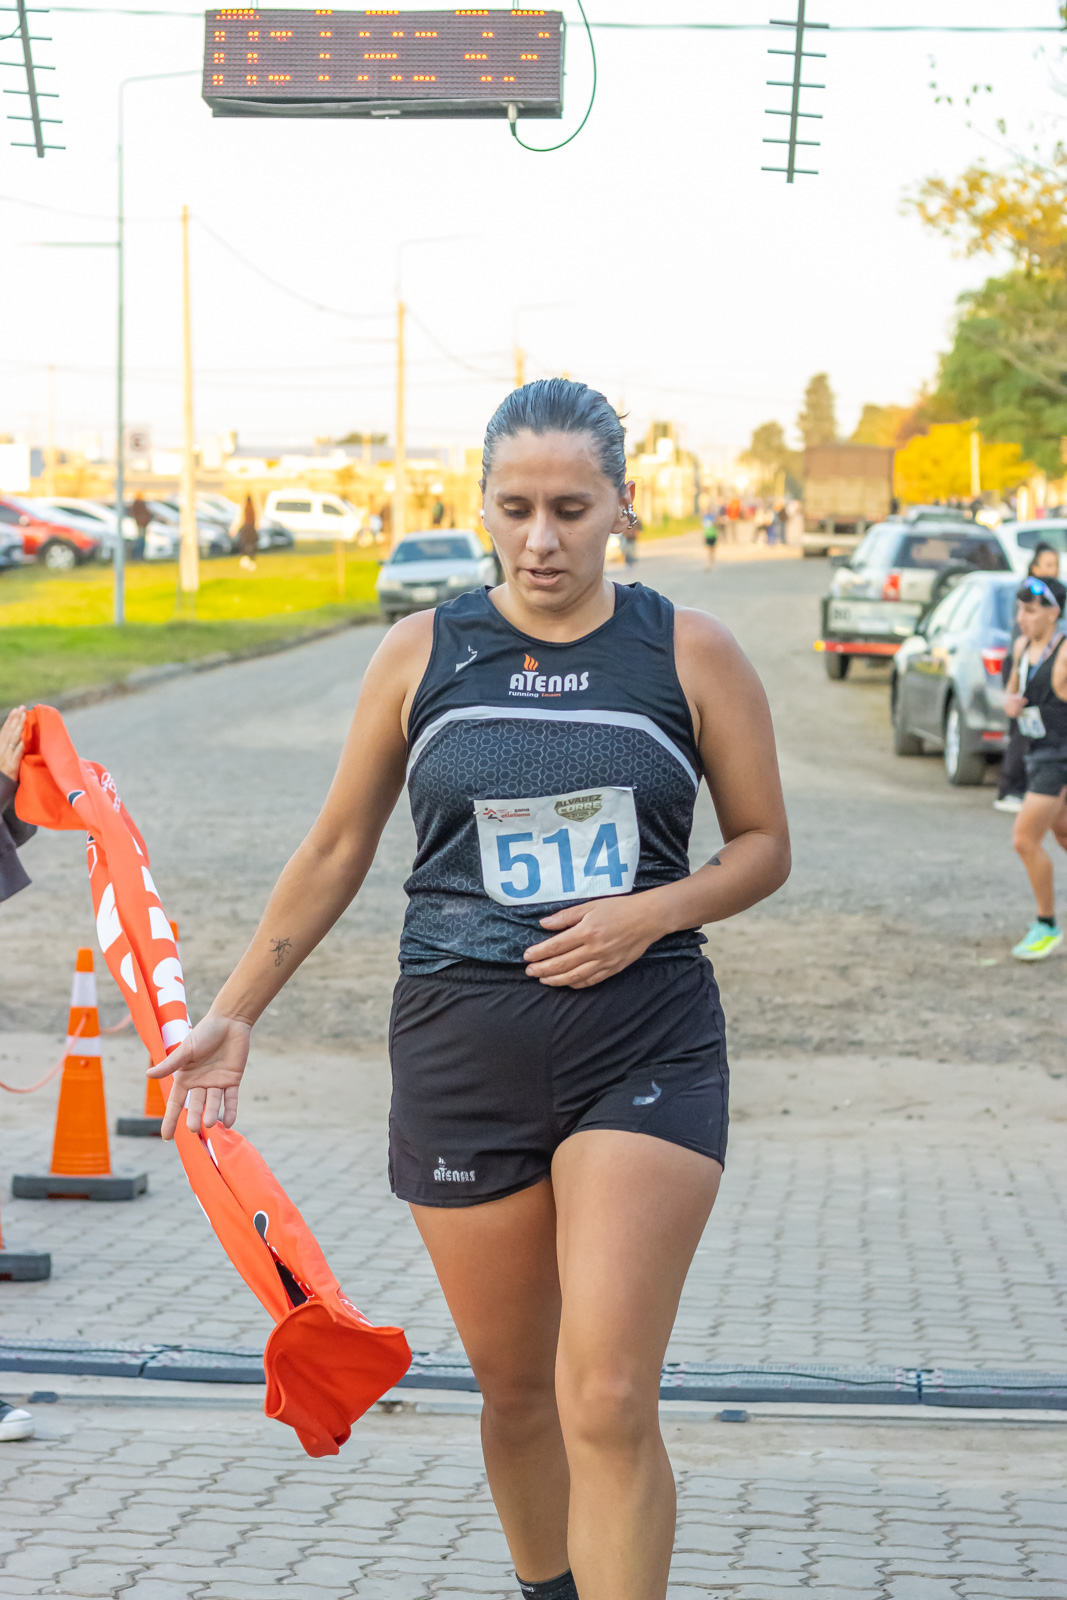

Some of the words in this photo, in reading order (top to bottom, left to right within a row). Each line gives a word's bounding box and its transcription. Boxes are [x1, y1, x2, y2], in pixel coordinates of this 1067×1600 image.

[509, 671, 589, 692] ATENAS
[555, 794, 602, 807] ALVAREZ
[557, 801, 602, 814] CORRE
[496, 822, 628, 899] 514
[433, 1167, 476, 1182] ATENAS
